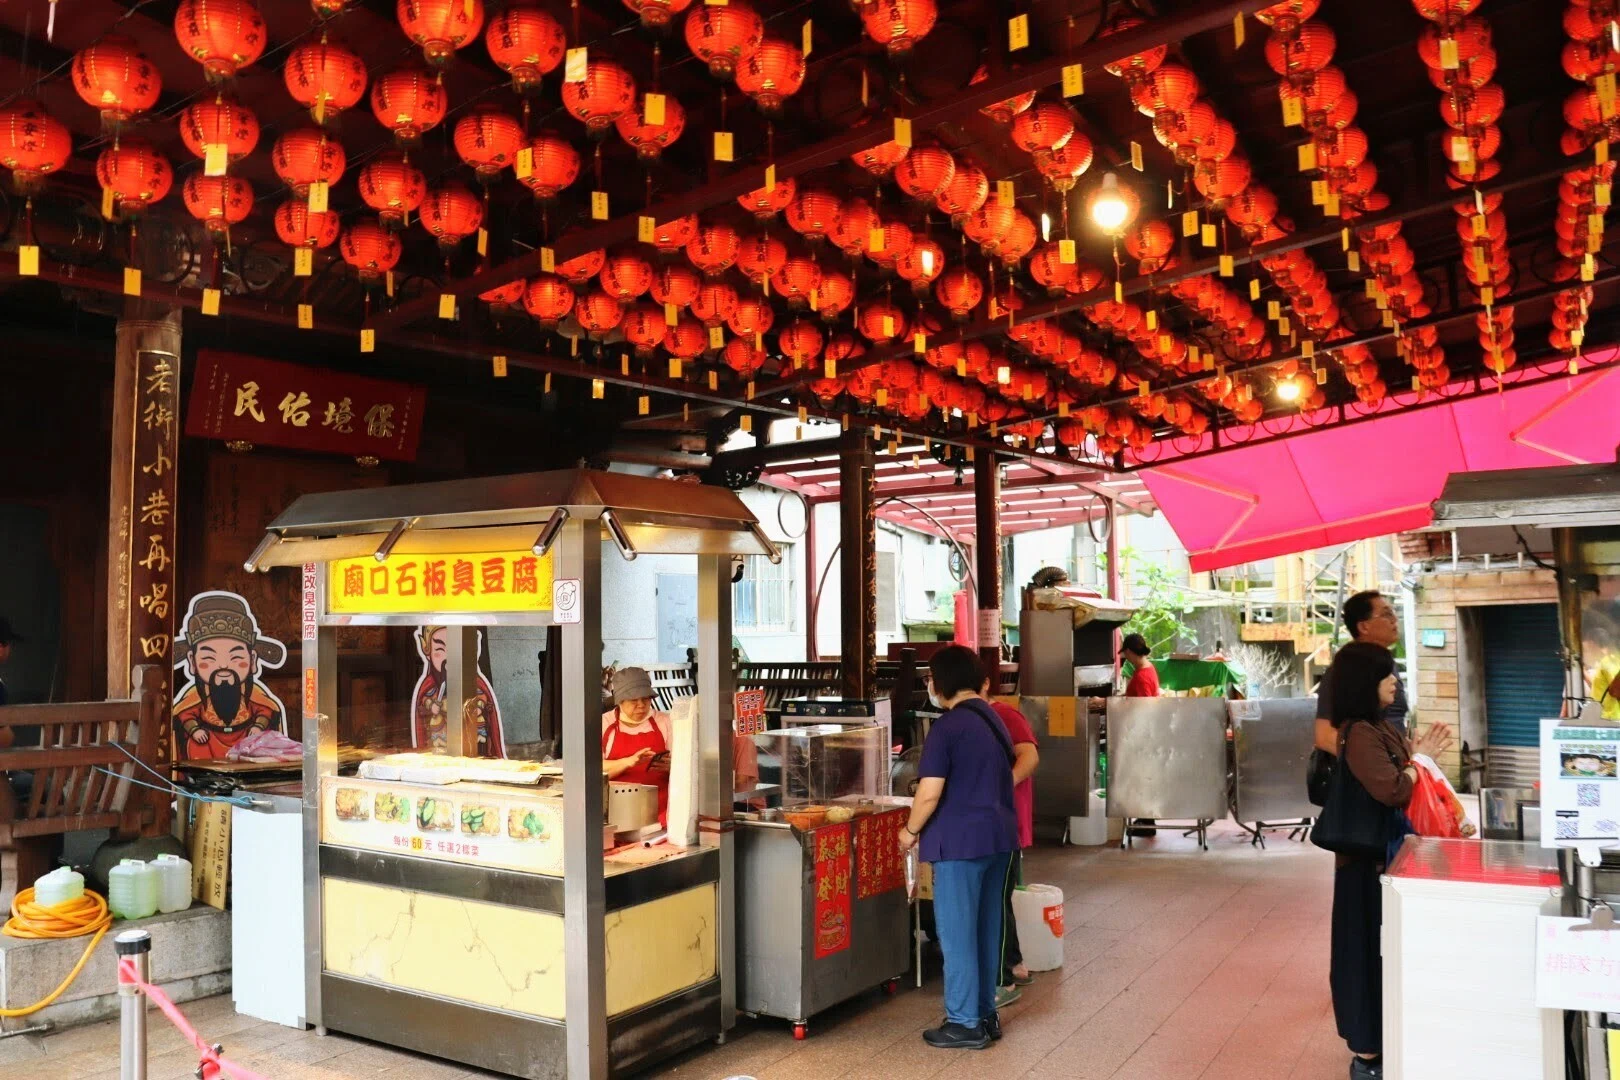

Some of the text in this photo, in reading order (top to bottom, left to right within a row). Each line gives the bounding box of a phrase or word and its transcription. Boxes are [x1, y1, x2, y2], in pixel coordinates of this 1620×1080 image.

[233, 381, 395, 438] 保境佑民
[139, 358, 174, 757] 老街小巷再唱四
[343, 556, 539, 597] 廟口石板臭豆腐
[302, 561, 317, 640] 基改臭豆腐
[1544, 952, 1620, 977] 排隊方
